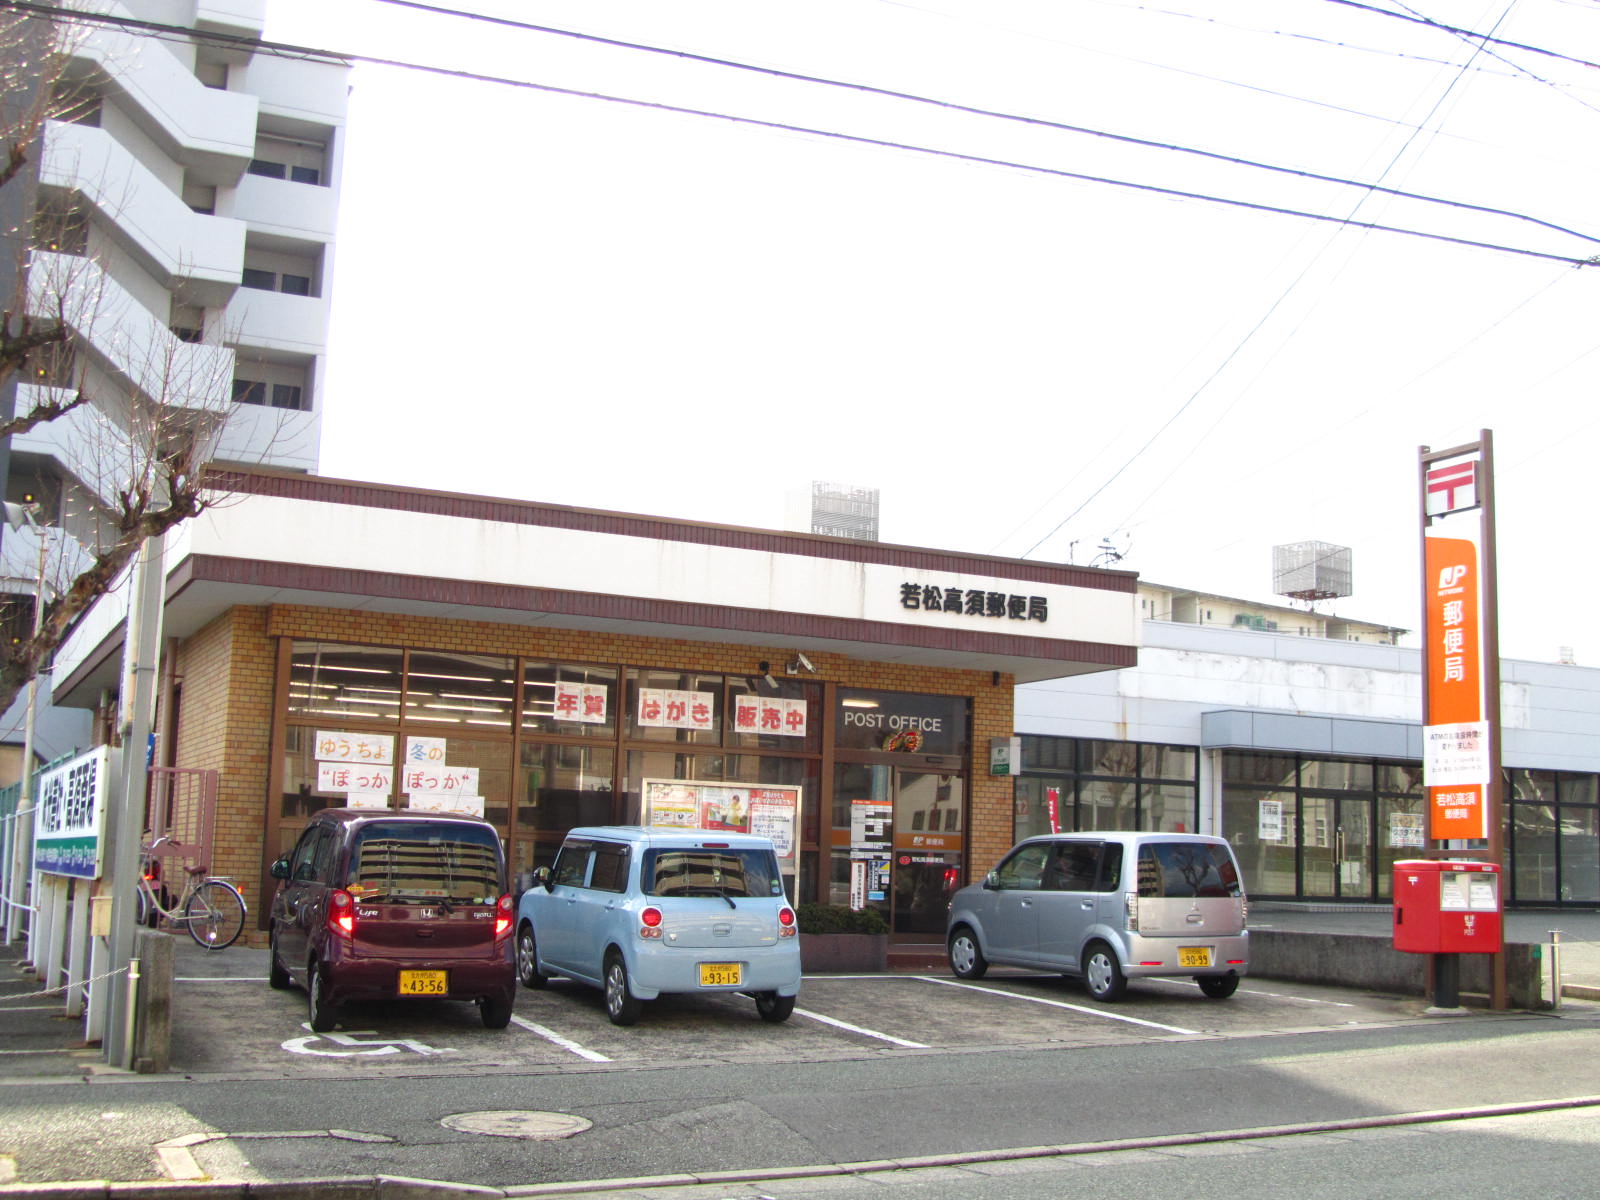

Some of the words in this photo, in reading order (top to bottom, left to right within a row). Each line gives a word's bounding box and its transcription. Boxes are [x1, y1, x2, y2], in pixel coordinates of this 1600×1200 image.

[900, 582, 1048, 623] 若松高須郵便局
[1443, 600, 1464, 682] 郵便局
[556, 692, 605, 717] 年賀
[641, 698, 710, 723] はがき
[736, 705, 805, 731] 販売中
[844, 712, 885, 728] POST
[888, 715, 942, 732] OFFICE
[319, 739, 387, 760] ゆうちょ
[410, 743, 443, 761] 冬の
[1436, 793, 1475, 806] 若松高須
[410, 980, 443, 992] 43-56
[710, 973, 738, 984] 93-15
